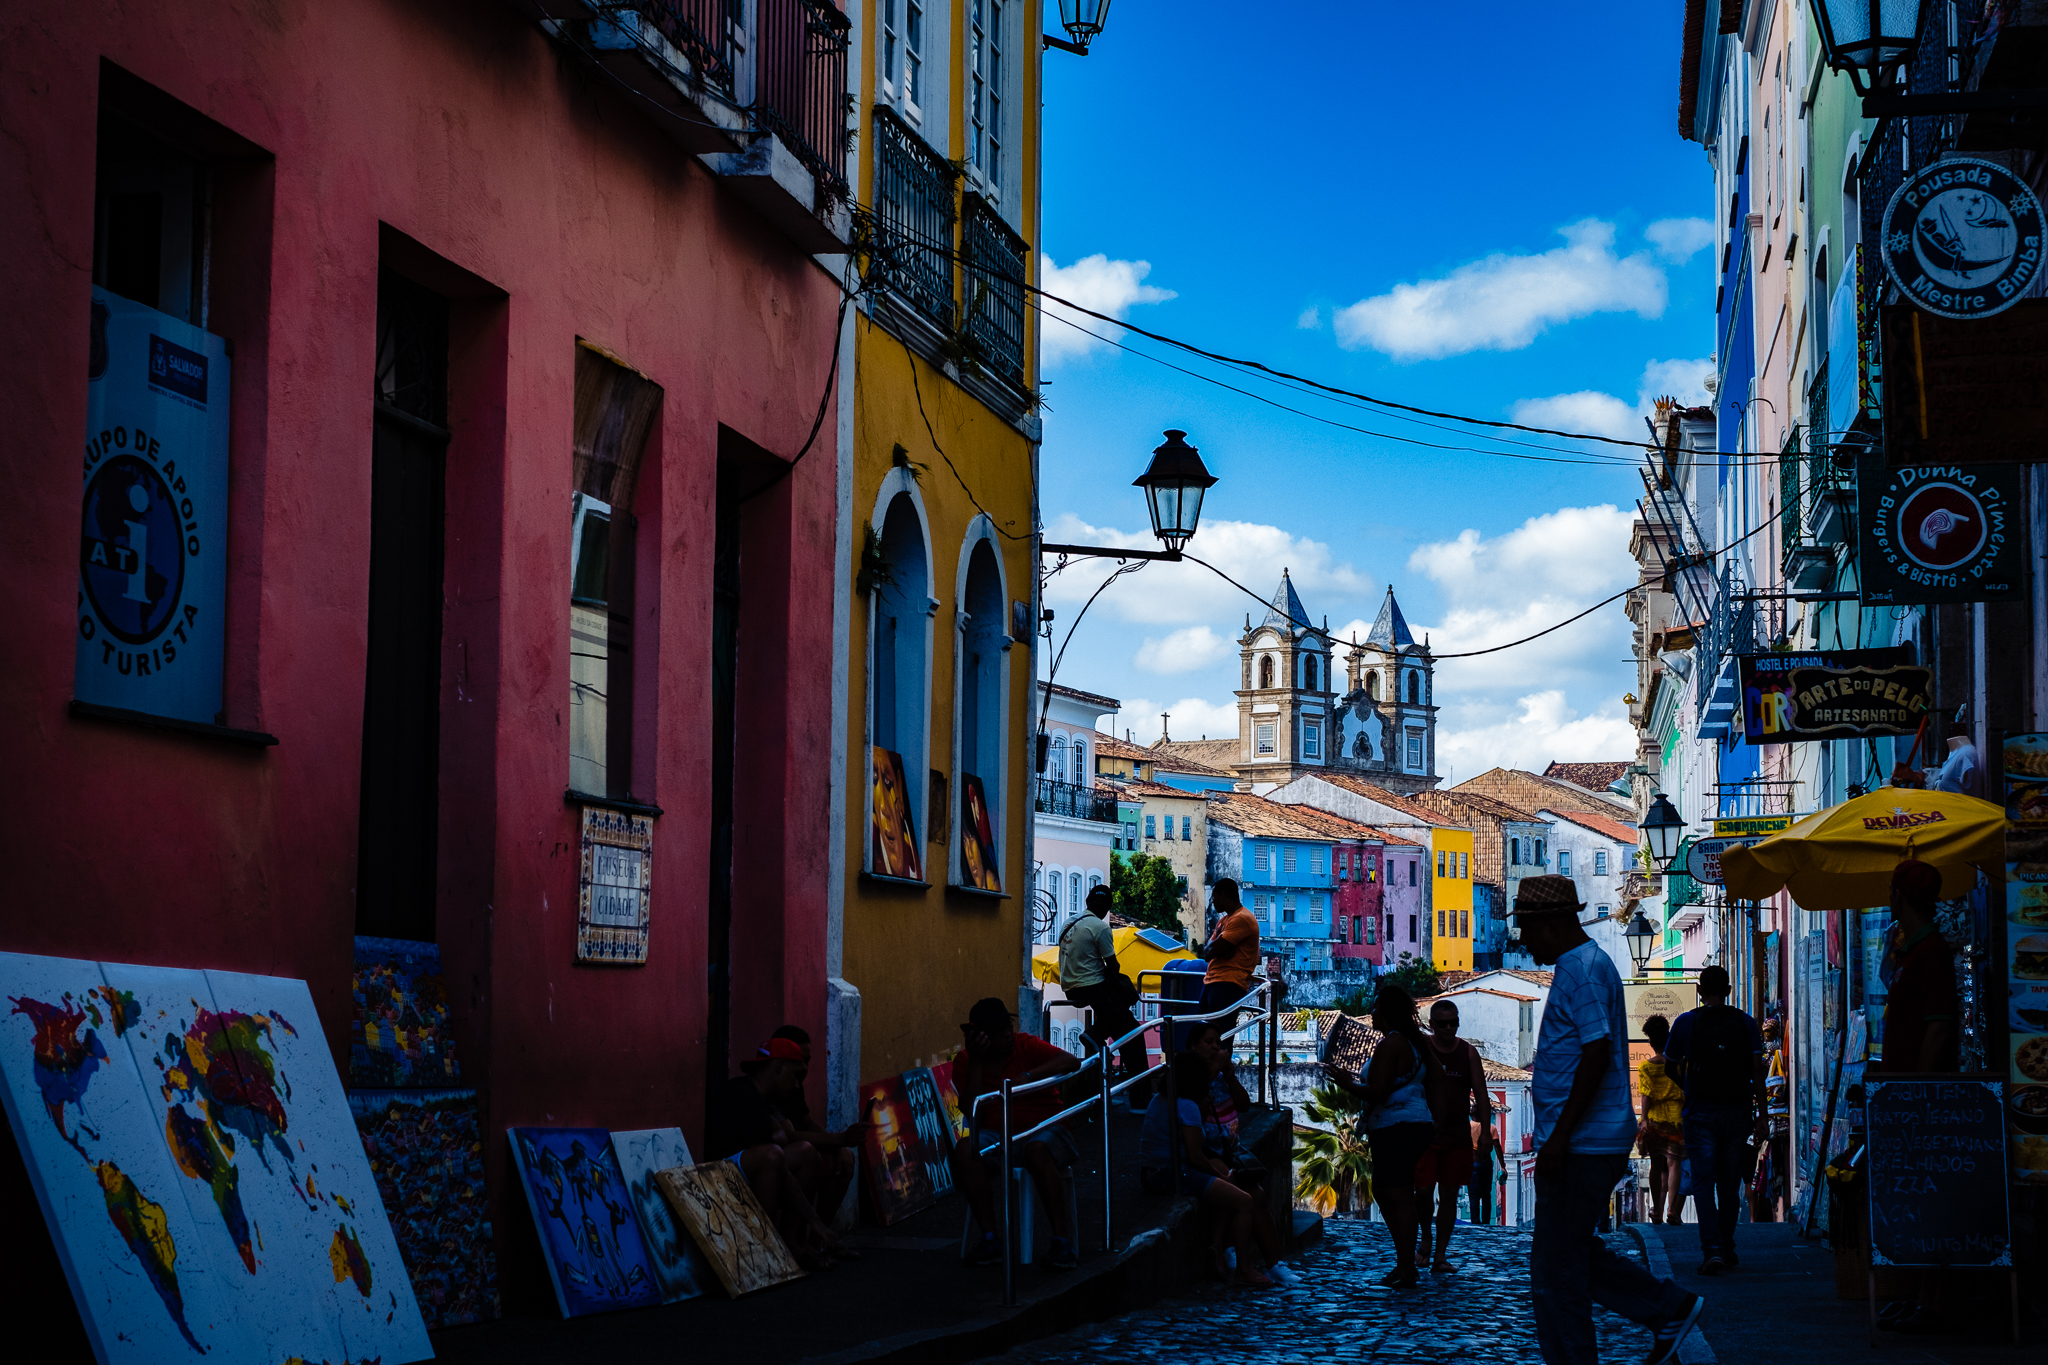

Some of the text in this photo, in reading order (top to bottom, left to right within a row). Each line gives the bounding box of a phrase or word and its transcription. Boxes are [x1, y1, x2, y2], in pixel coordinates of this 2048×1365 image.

[1904, 166, 1993, 209] Pousada
[1910, 235, 2040, 310] Mestre Bimba
[135, 428, 161, 463] DE
[162, 459, 200, 557] APOIO
[1897, 466, 1977, 488] Donna
[1969, 486, 2007, 579] Pimenta
[1872, 495, 1957, 588] Burgers & Bistrô
[102, 603, 199, 677] TURISTA
[1755, 658, 1783, 671] HOSTEL
[1783, 657, 1789, 671] E
[1798, 677, 1855, 711] ARTE
[1853, 679, 1871, 691] DO
[1814, 708, 1908, 722] ARTESANATO
[1862, 810, 1946, 828] DEVASSA
[1697, 841, 1724, 854] BAHIA
[597, 855, 630, 877] MUSEU
[597, 895, 635, 917] CIDADE
[1887, 1082, 1927, 1101] AQUI
[1920, 1102, 1985, 1125] VEGANO
[1870, 1151, 1976, 1173] GRELHADOS
[1872, 1172, 1938, 1197] PIZZA
[1964, 1232, 2006, 1255] MAIS
